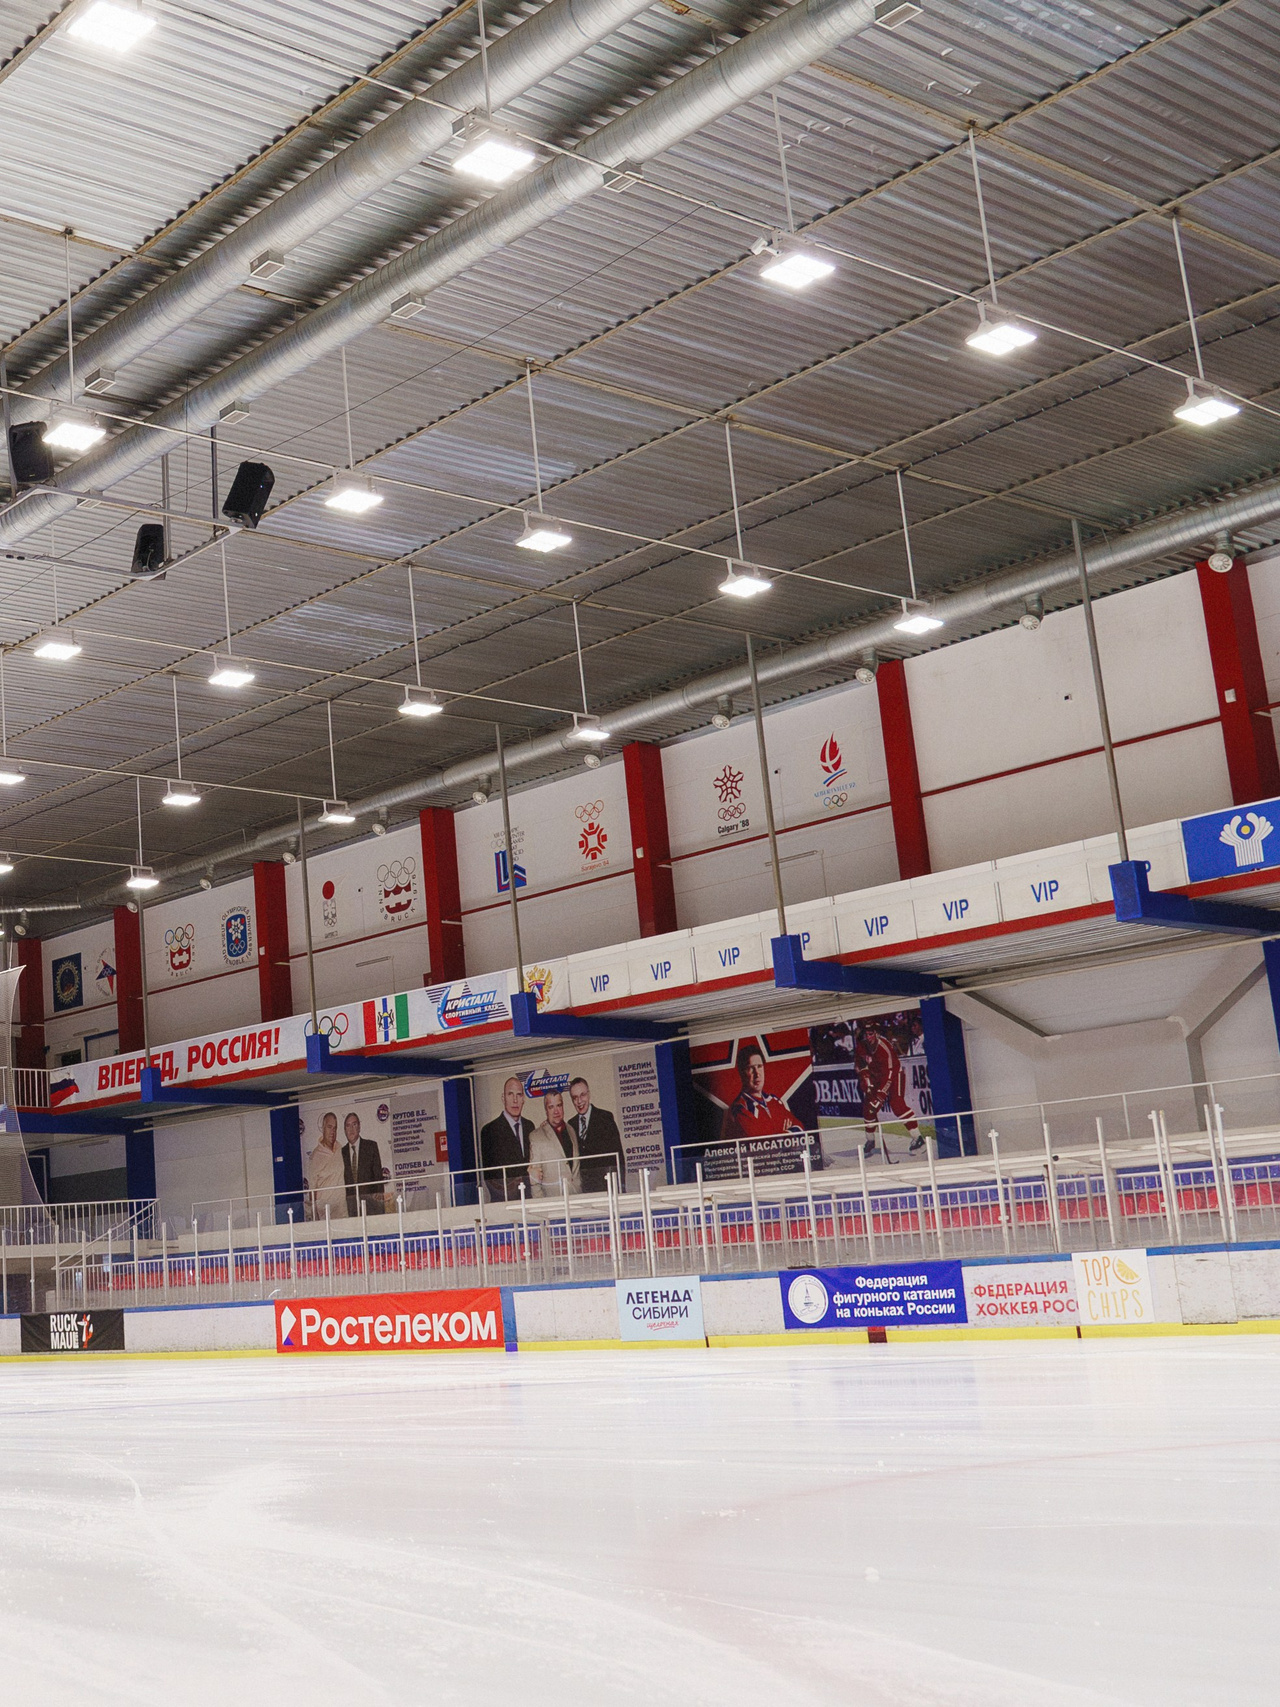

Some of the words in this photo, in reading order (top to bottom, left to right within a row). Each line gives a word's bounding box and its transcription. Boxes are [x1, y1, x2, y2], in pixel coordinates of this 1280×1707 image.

[718, 823, 738, 834] Calgary
[1030, 880, 1060, 903] VIP
[942, 899, 970, 922] VIP
[864, 916, 890, 938] VIP
[718, 947, 741, 968] VIP
[650, 961, 672, 981] VIP
[590, 974, 610, 993] VIP
[446, 992, 495, 1011] КРИСТАЛЛ
[187, 1027, 281, 1073] РОССИЯ!
[618, 1061, 652, 1073] КАРЕЛИН
[531, 1075, 568, 1086] КРИСТАЛЛ
[393, 1111, 415, 1120] КРУТОВ
[622, 1103, 655, 1113] ГОЛУБЕВ
[626, 1144, 661, 1154] ФЕТИСОВ
[749, 1135, 816, 1153] КАСАТОНОВ
[395, 1161, 422, 1170] ГОЛУБЕВ
[1081, 1256, 1111, 1287] TOP
[855, 1275, 928, 1289] Федерация
[973, 1280, 1068, 1300] ФЕДЕРАЦИЯ
[626, 1289, 693, 1305] ЛЕГЕНДА
[833, 1292, 900, 1307] фигурного
[903, 1288, 956, 1301] катания
[1087, 1288, 1144, 1321] CHIPS
[632, 1306, 689, 1320] СИБИРИ
[836, 1308, 851, 1318] на
[854, 1306, 904, 1317] коньках
[907, 1302, 956, 1315] России
[976, 1301, 1038, 1317] ХОККЕЯ
[1042, 1298, 1079, 1313] РОС
[50, 1313, 79, 1332] RUCK
[300, 1308, 498, 1346] Ростелеком
[51, 1331, 80, 1349] MAUL
